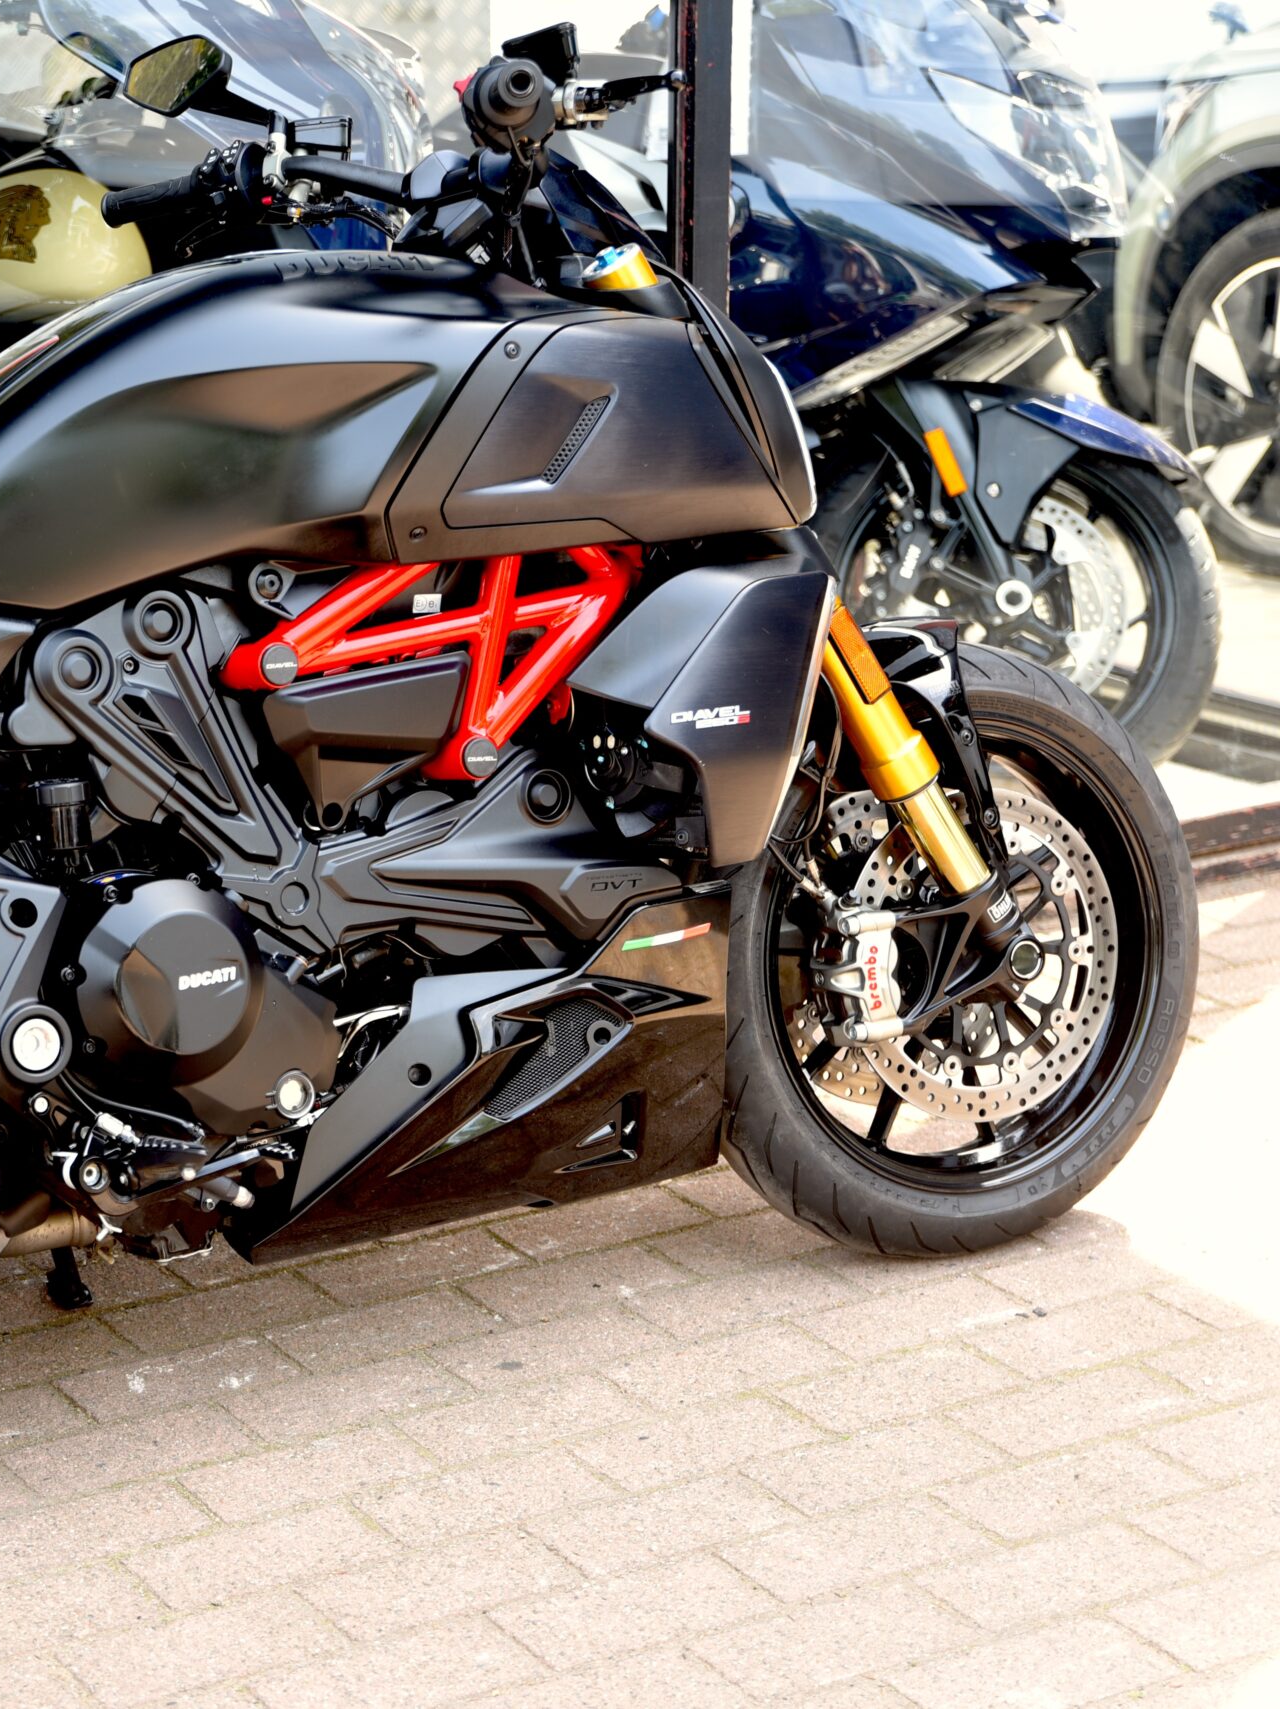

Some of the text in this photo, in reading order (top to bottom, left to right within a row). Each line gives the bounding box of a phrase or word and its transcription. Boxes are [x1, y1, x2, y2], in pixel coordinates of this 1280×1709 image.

[273, 253, 435, 281] DUCATI
[266, 661, 298, 669] DIAVEL
[670, 705, 751, 724] DIAVEL
[590, 878, 643, 892] DVT
[178, 966, 236, 990] DUCATI
[864, 945, 883, 1011] brembo
[1136, 997, 1175, 1086] ROSSO
